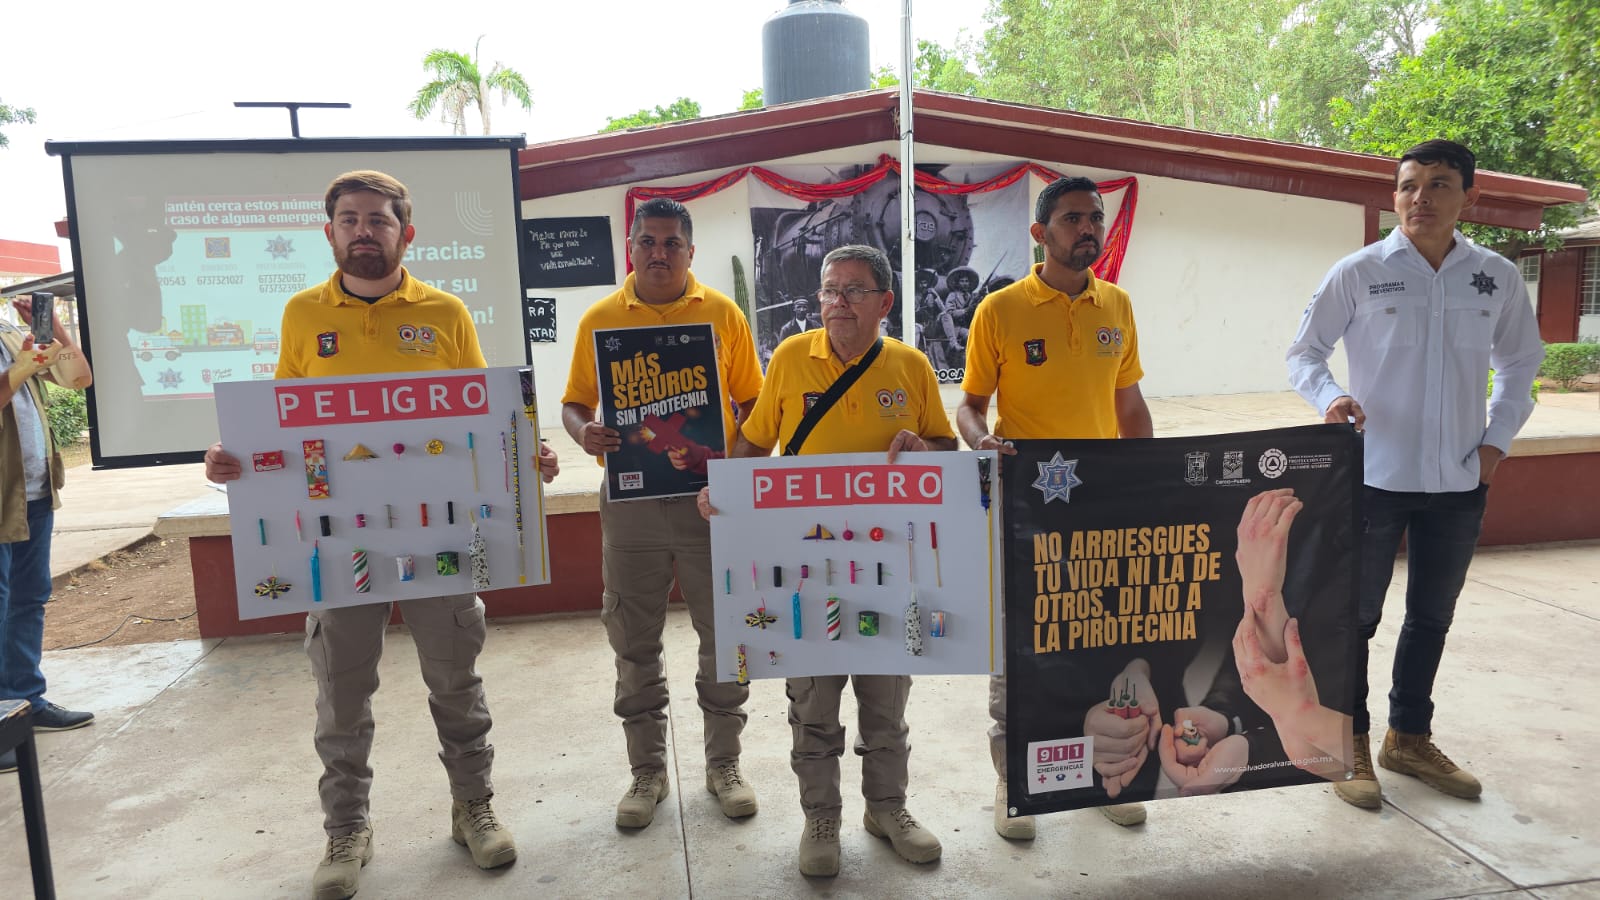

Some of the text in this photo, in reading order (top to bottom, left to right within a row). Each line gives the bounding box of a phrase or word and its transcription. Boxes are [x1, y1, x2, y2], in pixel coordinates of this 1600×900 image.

[165, 199, 327, 212] antén cerca estos númer
[171, 214, 199, 225] caso
[202, 212, 219, 224] de
[221, 212, 266, 226] alguna
[158, 276, 186, 286] 20543
[452, 278, 478, 293] su
[528, 306, 545, 317] RA
[610, 350, 661, 386] MÁS
[278, 381, 487, 421] PELIGRO
[613, 365, 708, 410] SEGUROS
[616, 390, 709, 426] SIN PIROTECNIA
[755, 471, 942, 503] PELIGRO
[1033, 523, 1210, 564] NO ARRIESGUES
[1033, 552, 1221, 594] TU VIDA NI LA DE
[1119, 586, 1142, 616] DI
[1149, 583, 1179, 613] NO
[1186, 582, 1201, 611] A
[1034, 610, 1197, 654] LA PIROTECNIA
[1037, 763, 1084, 774] EMERGENCIAS
[1039, 745, 1082, 762] 911
